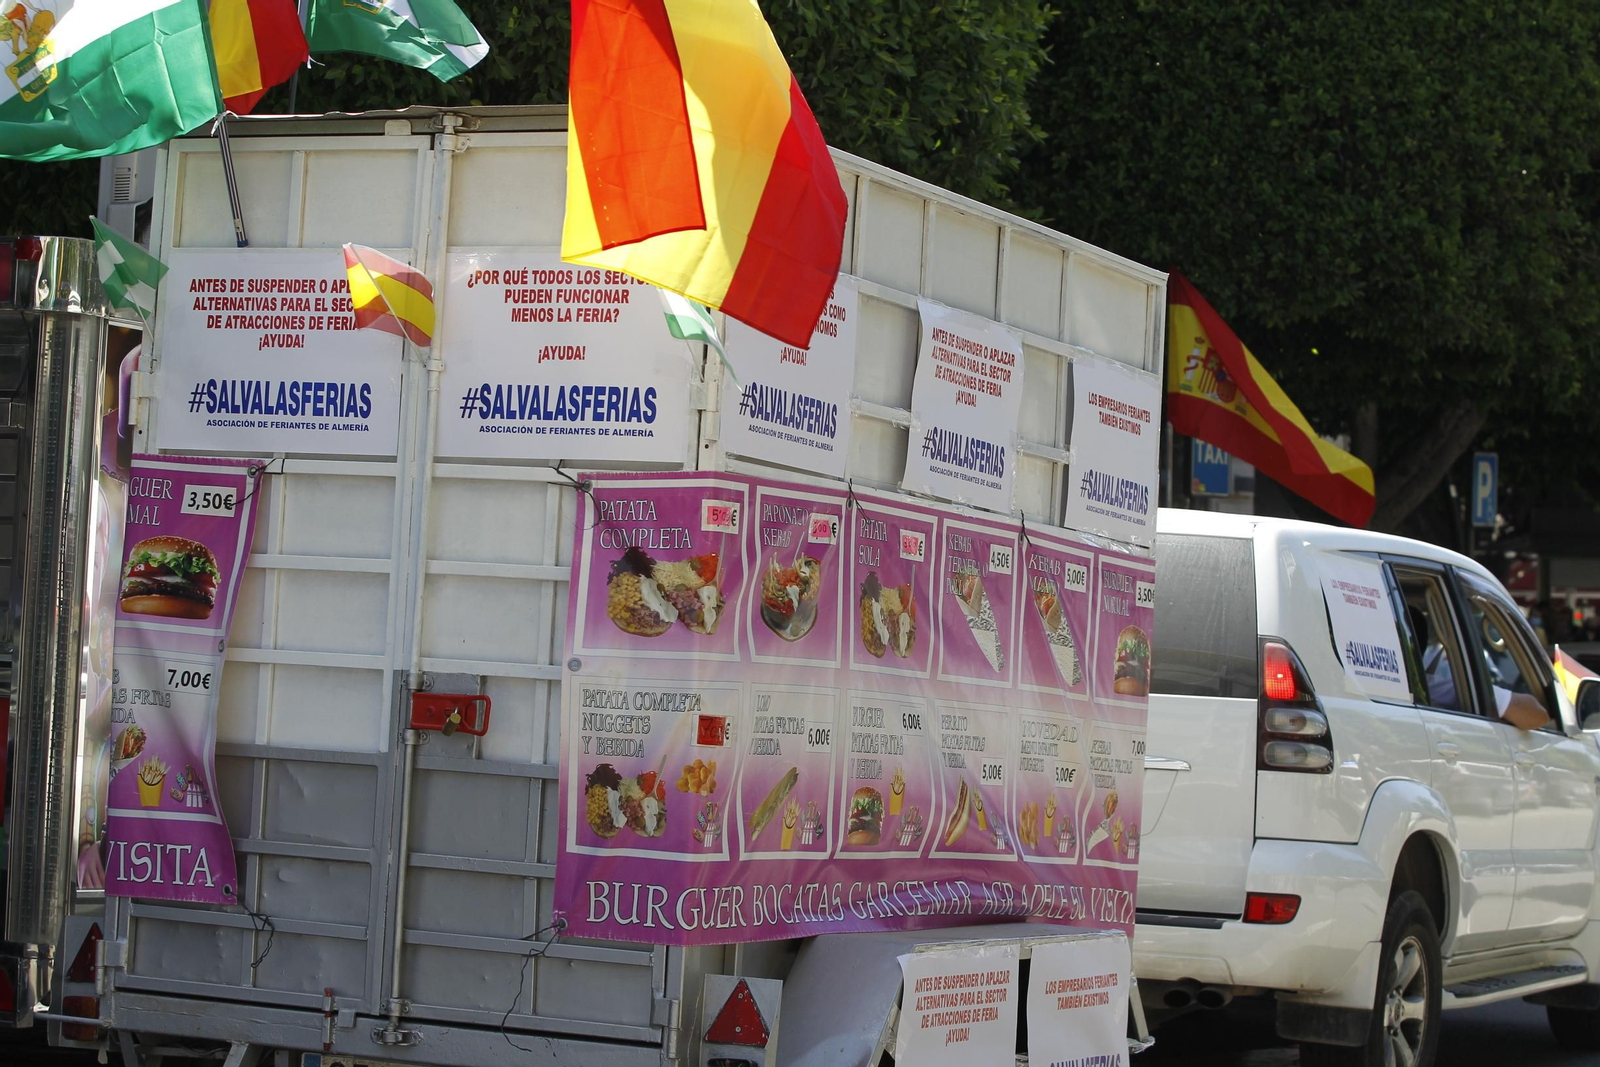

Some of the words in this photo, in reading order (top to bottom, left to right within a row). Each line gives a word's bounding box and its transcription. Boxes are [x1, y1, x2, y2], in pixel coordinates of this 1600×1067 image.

[188, 278, 226, 292] ANTES
[229, 278, 244, 292] DE
[247, 278, 316, 293] SUSPENDER
[319, 278, 327, 293] O
[467, 270, 499, 288] ¿POR
[502, 266, 528, 285] QUÉ
[531, 269, 573, 284] TODOS
[576, 269, 601, 285] LOS
[192, 296, 277, 311] ALTERNATIVAS
[280, 297, 310, 311] PARA
[314, 297, 328, 311] EL
[504, 288, 552, 303] PUEDEN
[555, 288, 629, 303] FUNCIONAR
[206, 314, 222, 328] DE
[224, 314, 305, 329] ATRACCIONES
[308, 315, 324, 330] DE
[326, 315, 357, 330] FERI
[511, 307, 553, 322] MENOS
[556, 307, 572, 322] LA
[575, 307, 619, 322] FERIA?
[829, 304, 846, 321] COMO
[258, 333, 304, 350] ¡AYUDA!
[931, 327, 948, 345] ANTES
[948, 332, 955, 348] DE
[954, 335, 984, 358] SUSPENDER
[983, 345, 988, 360] O
[988, 347, 1015, 367] APLAZAR
[537, 345, 585, 363] ¡AYUDA!
[780, 346, 807, 367] ¡AYUDA!
[931, 345, 966, 368] ALTERNATIVAS
[966, 357, 979, 374] PARA
[980, 362, 987, 376] EL
[988, 364, 1011, 382] SECTOR
[934, 364, 942, 378] DE
[941, 367, 977, 390] ATRACCIONES
[977, 378, 985, 392] DE
[985, 380, 1001, 397] FERIA
[188, 378, 372, 419] #SALVALASFERIAS
[459, 384, 656, 422] #SALVALASFERIAS
[955, 389, 977, 408] ¡AYUDA!
[738, 382, 838, 440] #SALVALASFERIAS
[206, 419, 255, 427] ASOCIACIÓN
[257, 420, 268, 428] DE
[270, 421, 316, 429] FERIANTES
[318, 422, 329, 430] DE
[331, 423, 369, 431] ALMERÍA
[478, 425, 532, 433] ASOCIACIÓN
[535, 426, 547, 434] DE
[549, 427, 595, 435] FERIANTES
[611, 428, 653, 437] ALMERÍA
[921, 427, 1005, 479] #SALVALASFERIAS
[127, 476, 173, 499] GUER
[1080, 468, 1149, 515] #SALVALASFERIAS
[1477, 461, 1493, 518] P
[188, 491, 233, 510] 3,50€
[600, 500, 657, 521] PATATA
[600, 528, 692, 549] COMPLETA
[764, 528, 792, 547] KEBAB
[860, 518, 888, 541] PATATA
[949, 533, 972, 553] KEBAB
[859, 544, 880, 567] SOLA
[991, 551, 1010, 568] 4,50€
[1028, 553, 1061, 576] KEBAB
[1067, 568, 1085, 585] 5,00€
[168, 669, 211, 689] 7,00€
[582, 689, 629, 710] PATATA
[632, 692, 702, 712] COMPLETA
[582, 712, 651, 734] NUGGETS
[902, 713, 922, 731] 6,00€
[582, 736, 592, 754] Y
[596, 738, 645, 757] BEBIDA
[808, 728, 830, 747] 6,00€
[982, 764, 1002, 781] 5,00€
[1056, 767, 1076, 783] 5,00€
[586, 881, 746, 930] BURGUER
[753, 882, 844, 926] BOCATAS
[849, 880, 972, 920] GARCEMAR
[914, 977, 933, 992] ANTES
[933, 976, 942, 990] DE
[942, 973, 979, 989] SUSPENDER
[979, 972, 984, 986] O
[984, 970, 1010, 985] APLAZAR
[915, 992, 958, 1011] ALTERNATIVAS
[958, 991, 975, 1006] PARA
[975, 990, 983, 1004] EL
[984, 988, 1007, 1003] SECTOR
[920, 1014, 930, 1028] DE
[929, 1009, 971, 1027] ATRACCIONES
[971, 1008, 981, 1022] DE
[980, 1006, 998, 1021] FERIA
[945, 1027, 970, 1046] ¡AYUDA!
